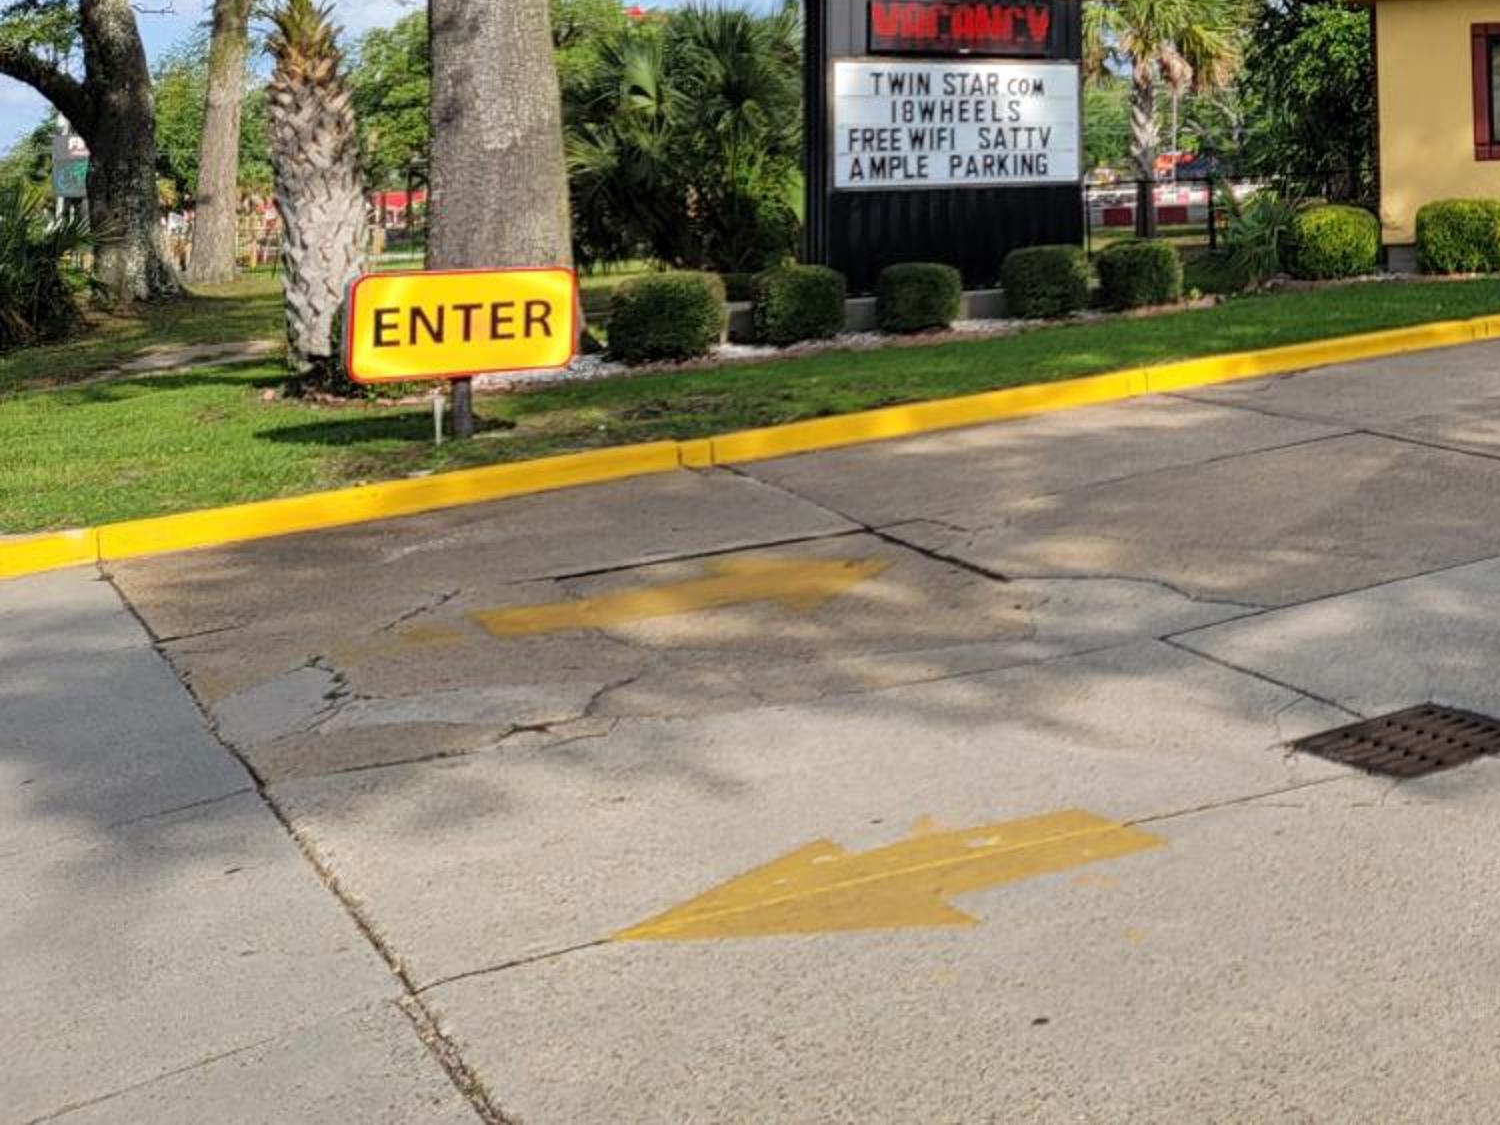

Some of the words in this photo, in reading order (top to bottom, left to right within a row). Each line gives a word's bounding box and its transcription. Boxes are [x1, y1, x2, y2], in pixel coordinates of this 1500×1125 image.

[870, 72, 931, 96] TWIN
[849, 128, 902, 151] FREE
[908, 127, 955, 150] WIFI
[850, 155, 928, 180] AMPLE
[950, 153, 1048, 178] PARKING
[373, 300, 552, 347] ENTER
